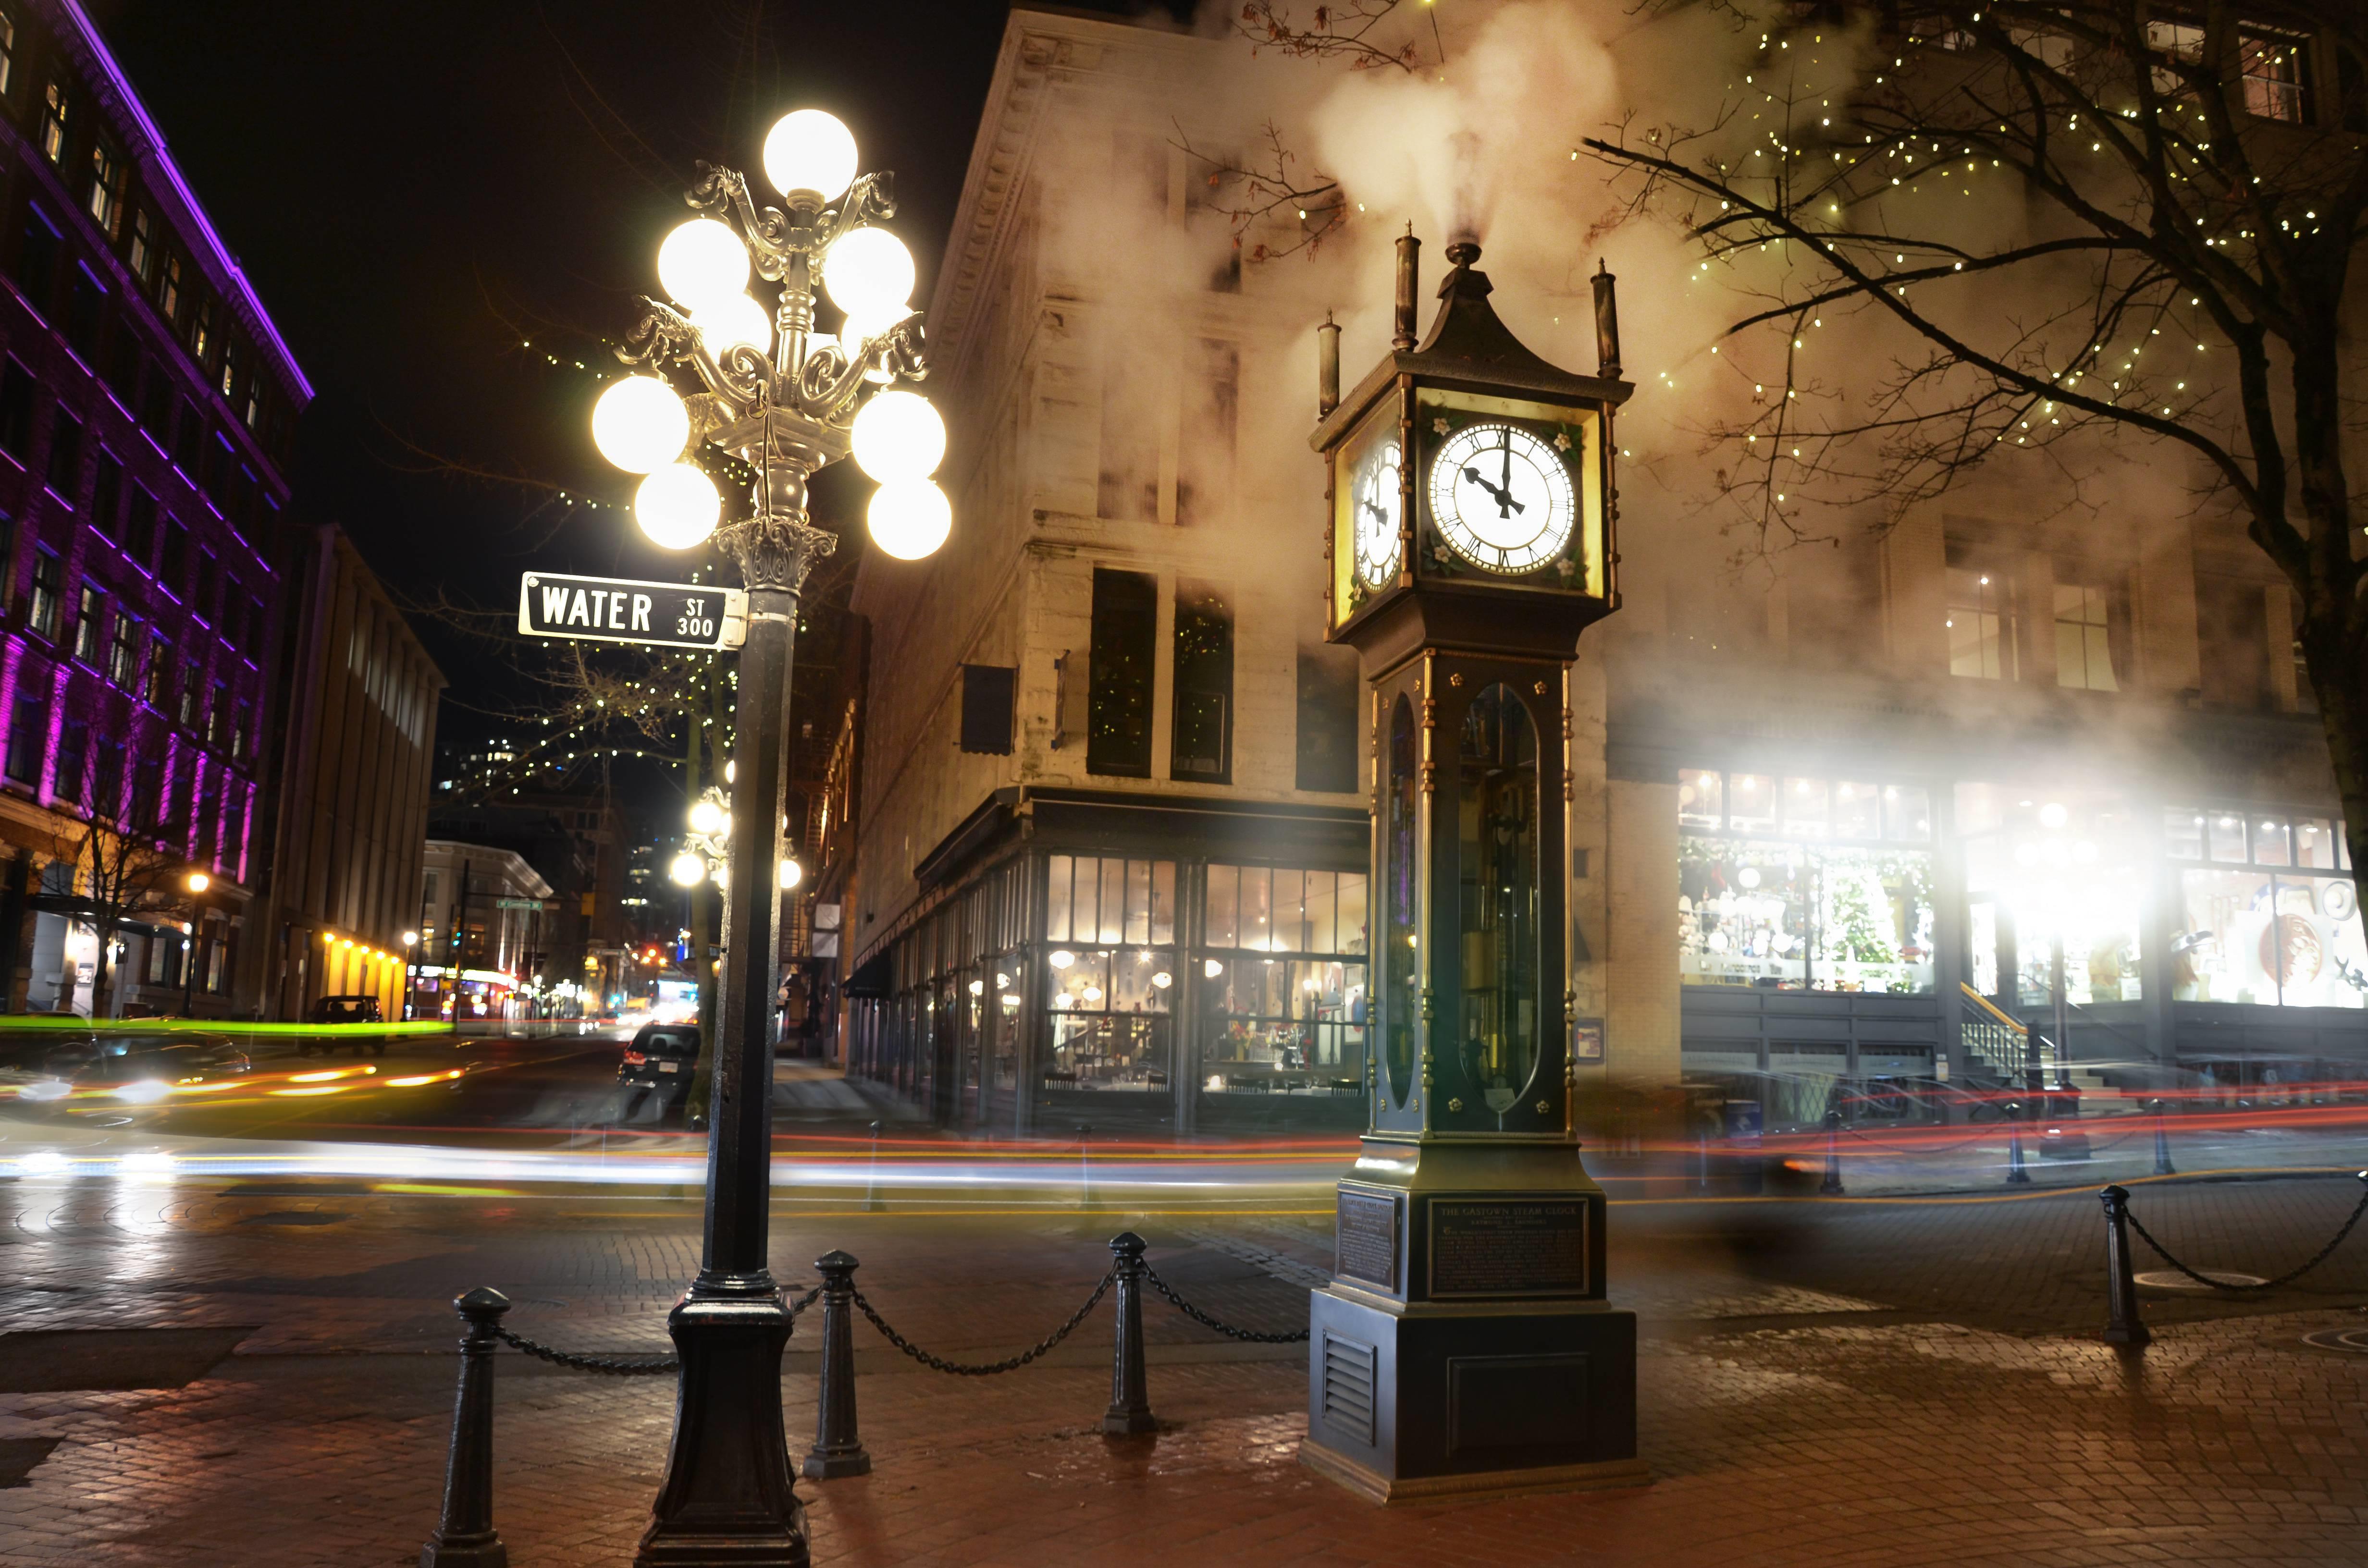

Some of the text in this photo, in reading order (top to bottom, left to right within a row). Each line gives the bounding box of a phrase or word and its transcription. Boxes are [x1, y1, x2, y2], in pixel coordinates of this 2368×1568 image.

[543, 586, 705, 631] WATER ST
[677, 617, 713, 637] 300
[1442, 1207, 1576, 1216] THE GASTOWN STEAM CLOCK
